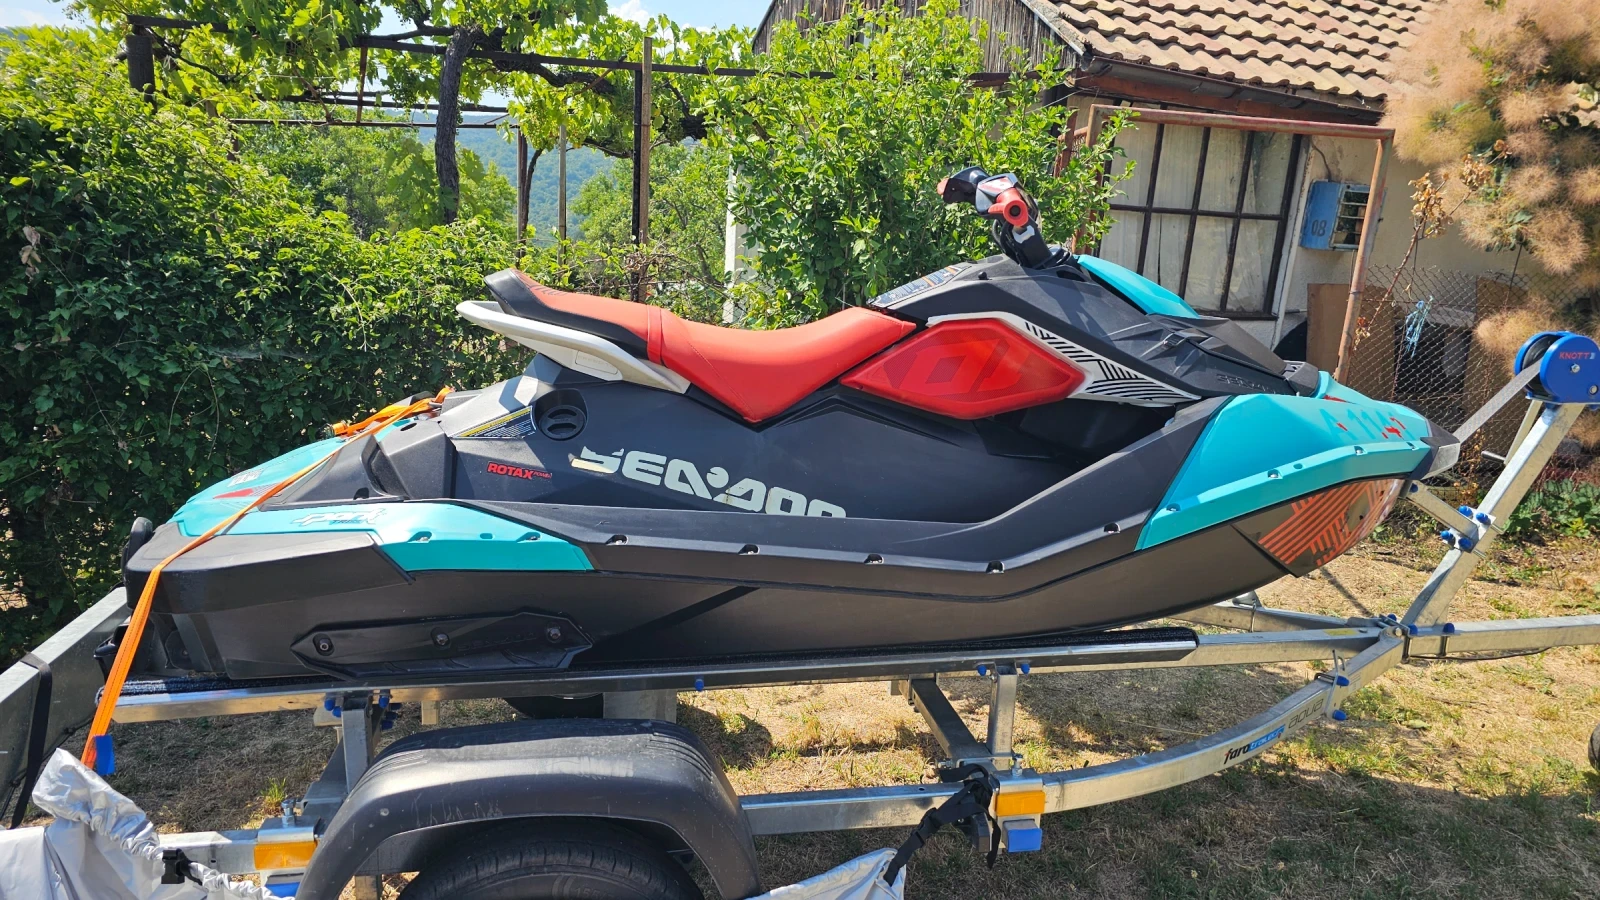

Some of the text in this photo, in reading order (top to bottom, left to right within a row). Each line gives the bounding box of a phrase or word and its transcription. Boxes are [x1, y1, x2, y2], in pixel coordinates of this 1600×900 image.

[1311, 219, 1328, 237] 08
[1559, 351, 1590, 360] KNOTT
[487, 462, 533, 480] ROTAX
